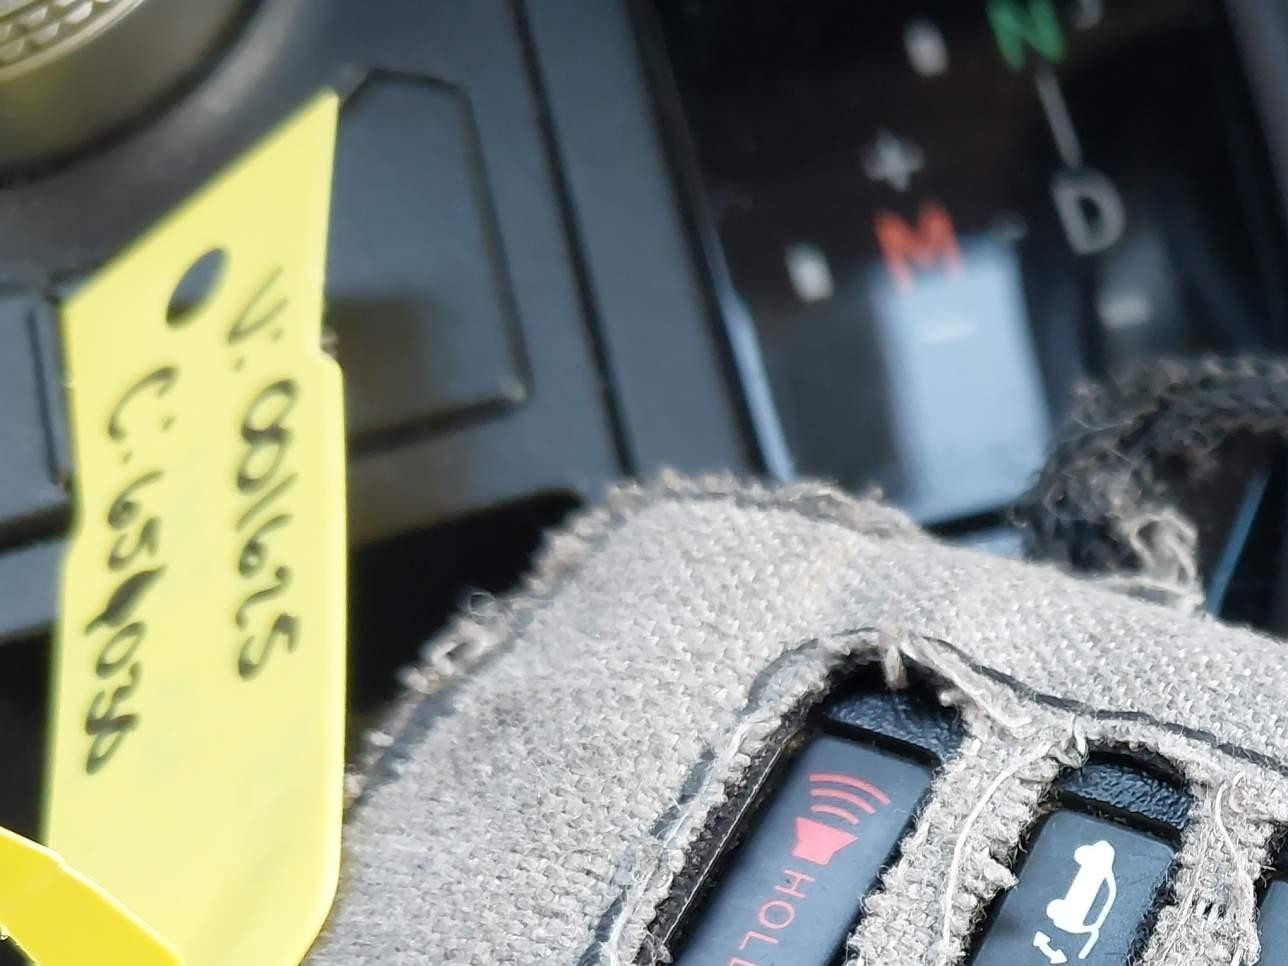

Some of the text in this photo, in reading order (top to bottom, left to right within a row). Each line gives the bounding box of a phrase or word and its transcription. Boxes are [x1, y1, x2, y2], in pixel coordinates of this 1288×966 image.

[986, 0, 1063, 72] N
[874, 203, 963, 296] M
[1051, 167, 1126, 256] D
